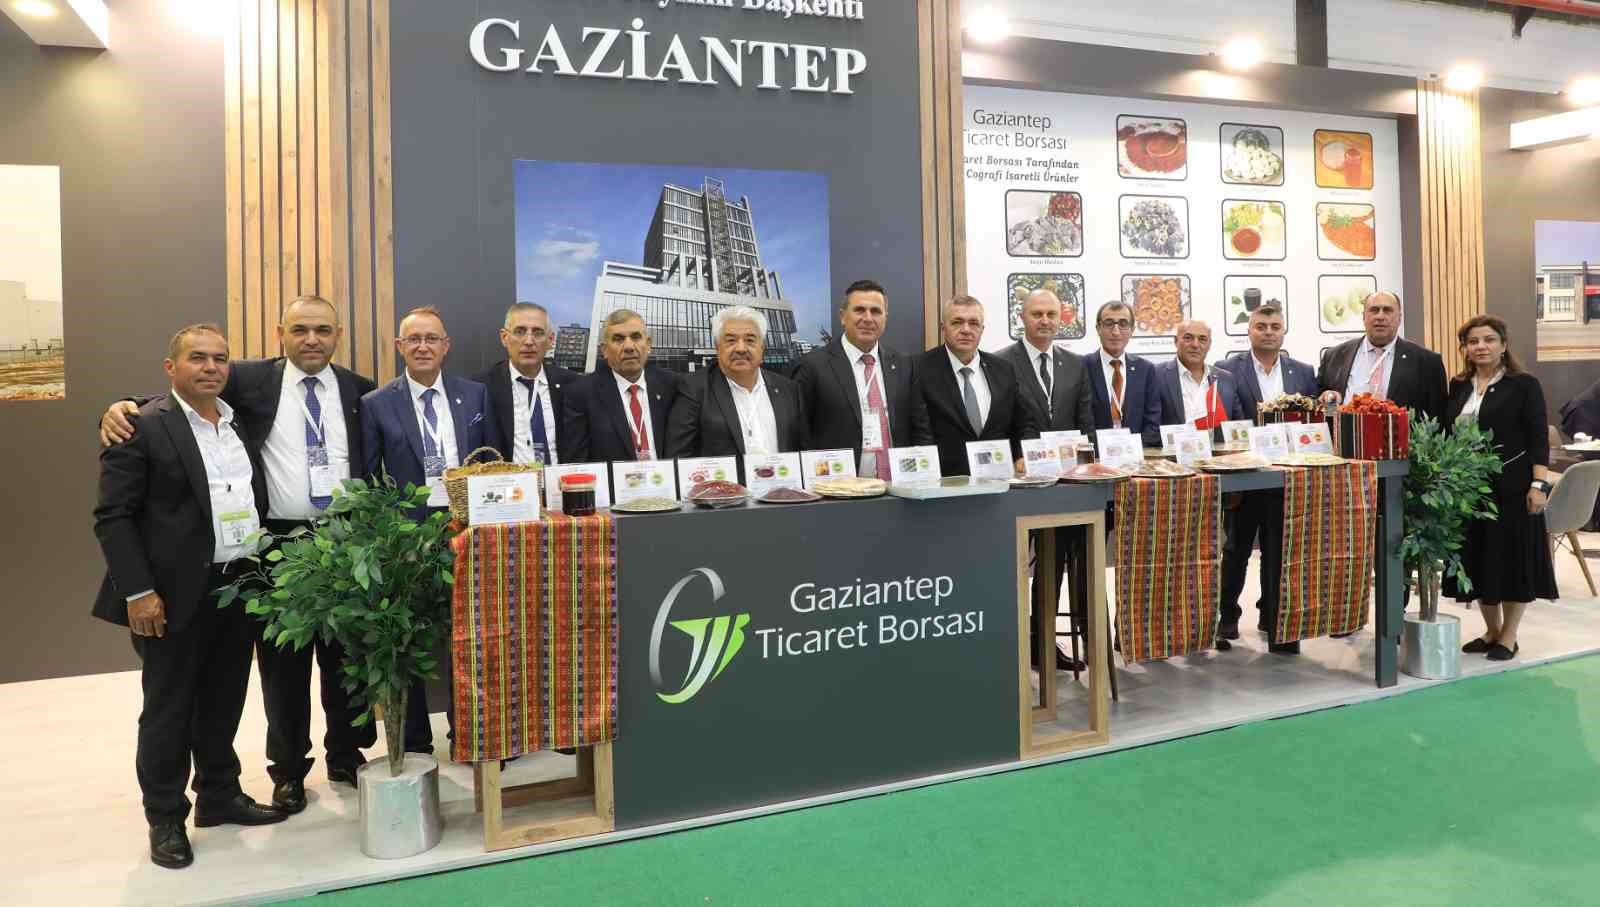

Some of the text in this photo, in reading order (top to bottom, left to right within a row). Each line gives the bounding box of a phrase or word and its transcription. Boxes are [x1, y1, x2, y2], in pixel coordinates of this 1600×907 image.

[469, 17, 867, 95] GAZİANTEP
[973, 109, 1051, 133] Gaziantep
[1014, 132, 1067, 150] Borsası
[986, 154, 1022, 167] Borsası
[1026, 156, 1080, 170] Tarafından
[790, 574, 954, 614] Gaziantep
[755, 610, 984, 659] Ticaret Borsası
